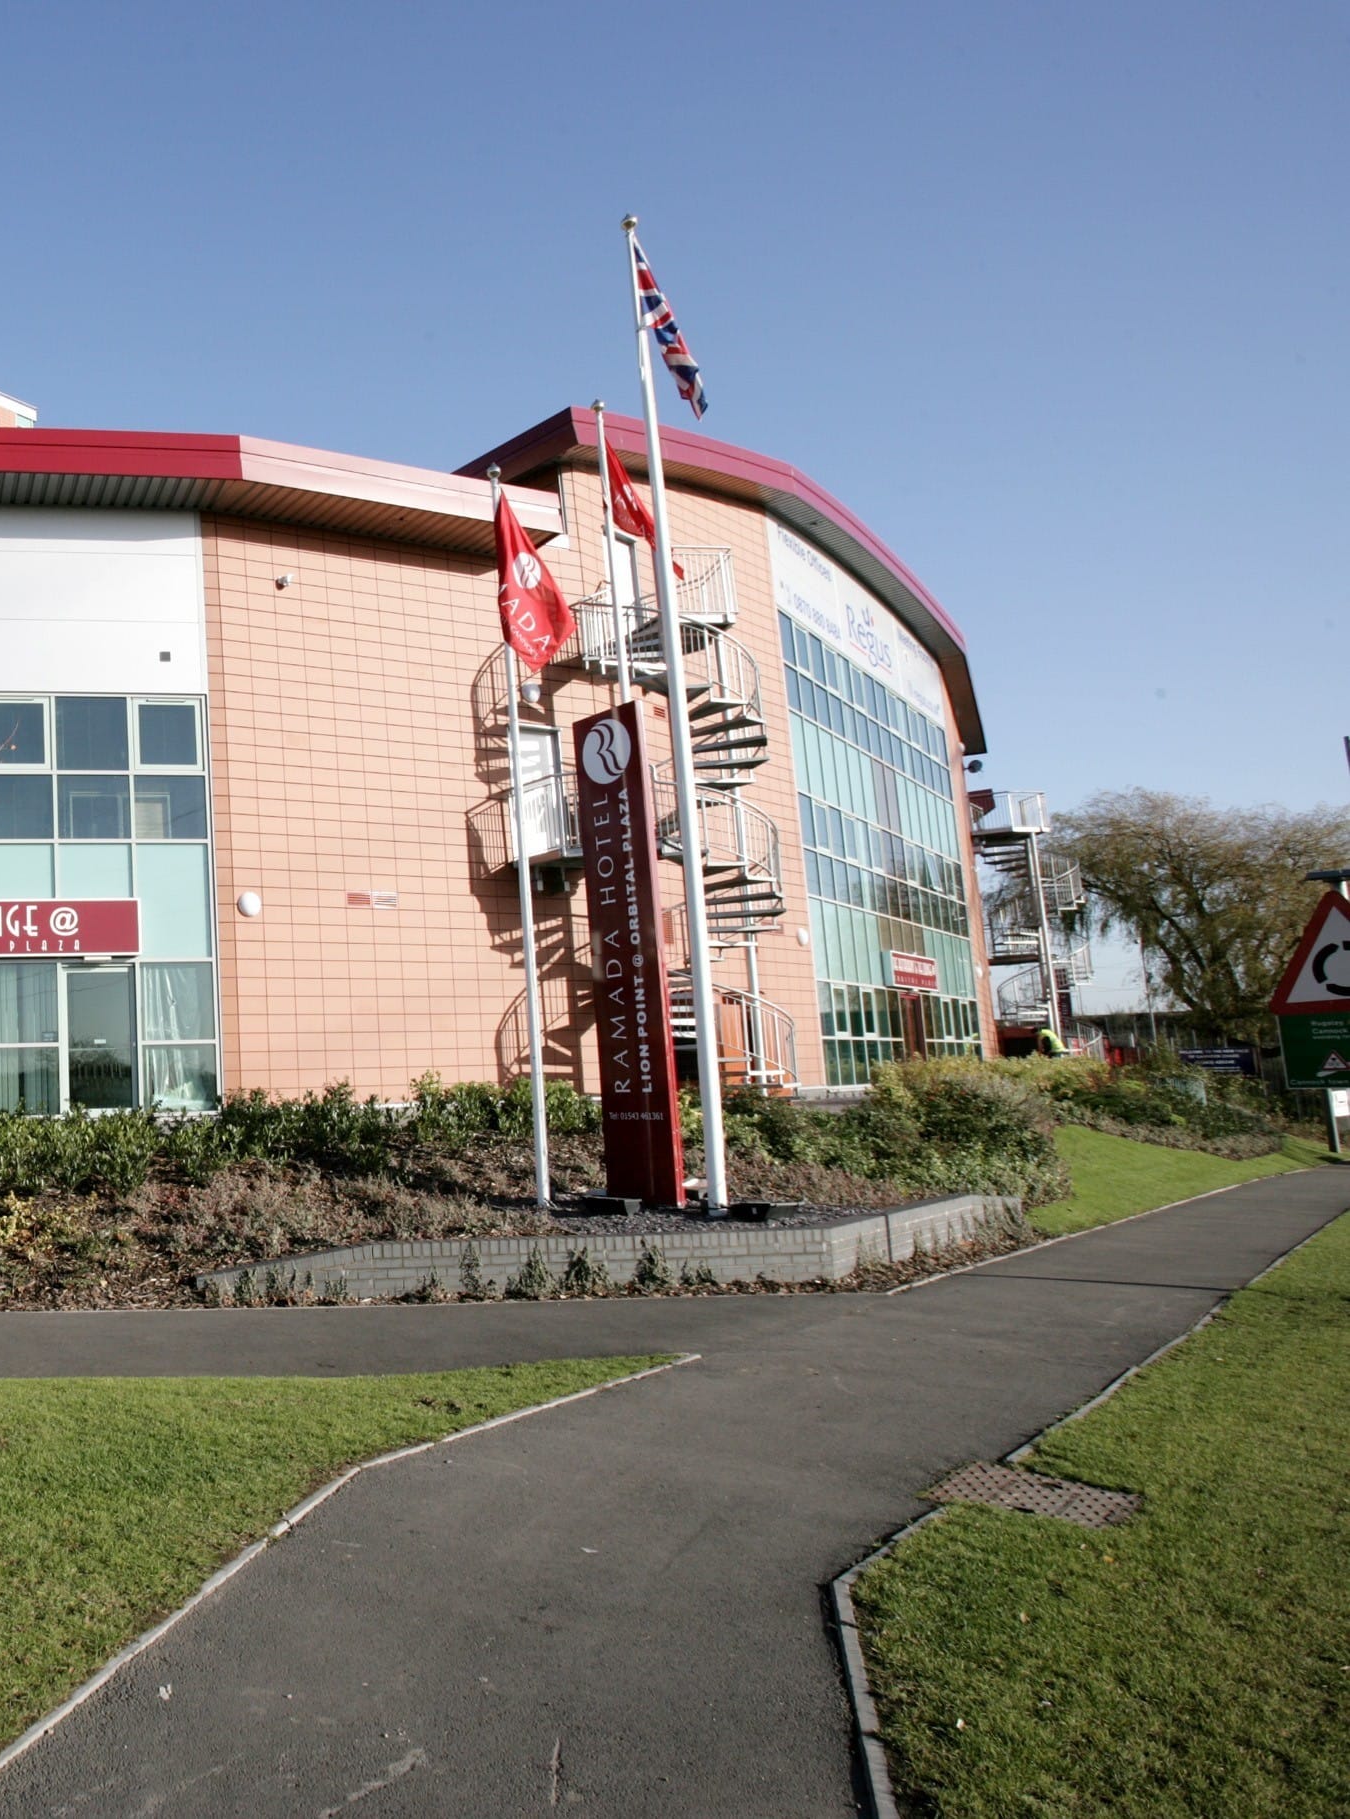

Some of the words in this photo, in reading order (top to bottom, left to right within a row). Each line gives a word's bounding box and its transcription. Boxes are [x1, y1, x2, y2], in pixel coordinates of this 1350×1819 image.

[845, 603, 893, 668] Regus
[593, 793, 617, 905] HOTEL
[618, 788, 634, 851] PLAZA
[50, 906, 79, 936] @
[624, 858, 640, 945] ORBITAL
[9, 939, 80, 952] PLAZA
[632, 954, 644, 967] @
[604, 930, 631, 1094] RAMADA
[634, 976, 650, 1038] POINT
[640, 1045, 652, 1094] LION
